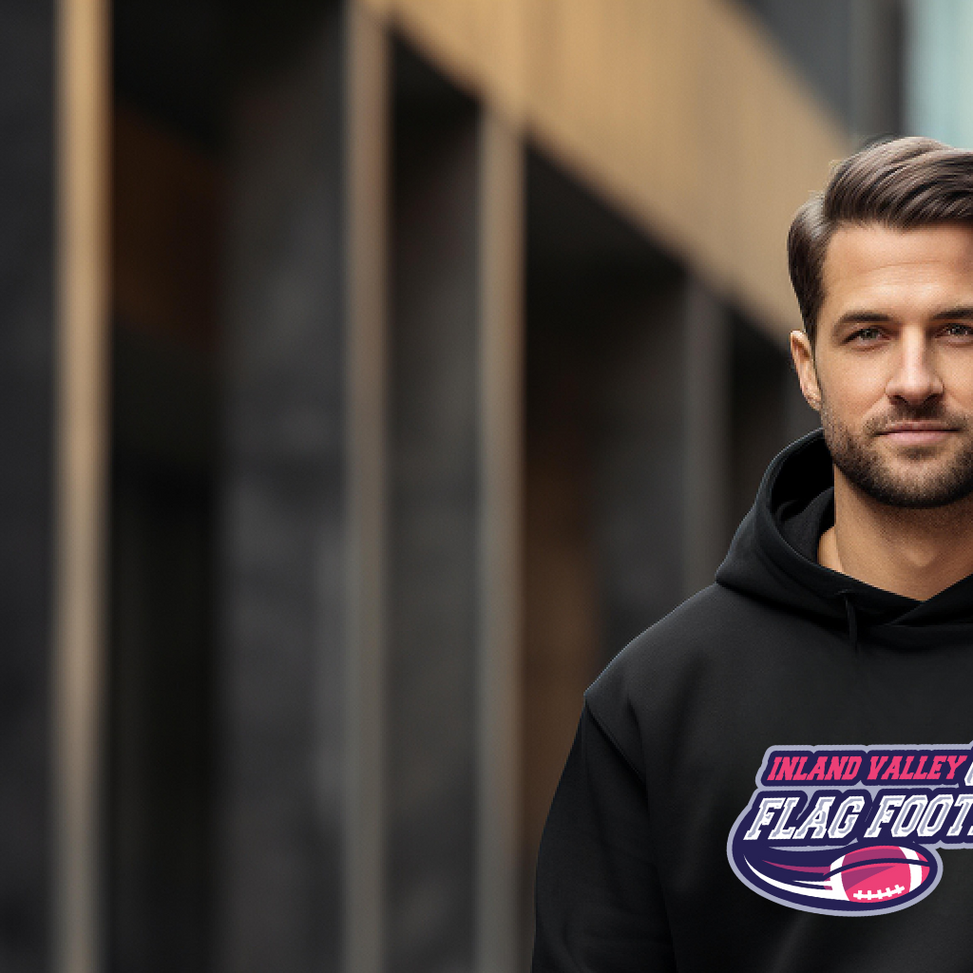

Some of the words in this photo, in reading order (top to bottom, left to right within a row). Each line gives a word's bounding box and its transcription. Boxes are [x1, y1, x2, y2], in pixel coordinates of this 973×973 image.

[767, 756, 862, 781] INLAND
[865, 755, 968, 780] VALLEY
[743, 796, 865, 840] FLAG
